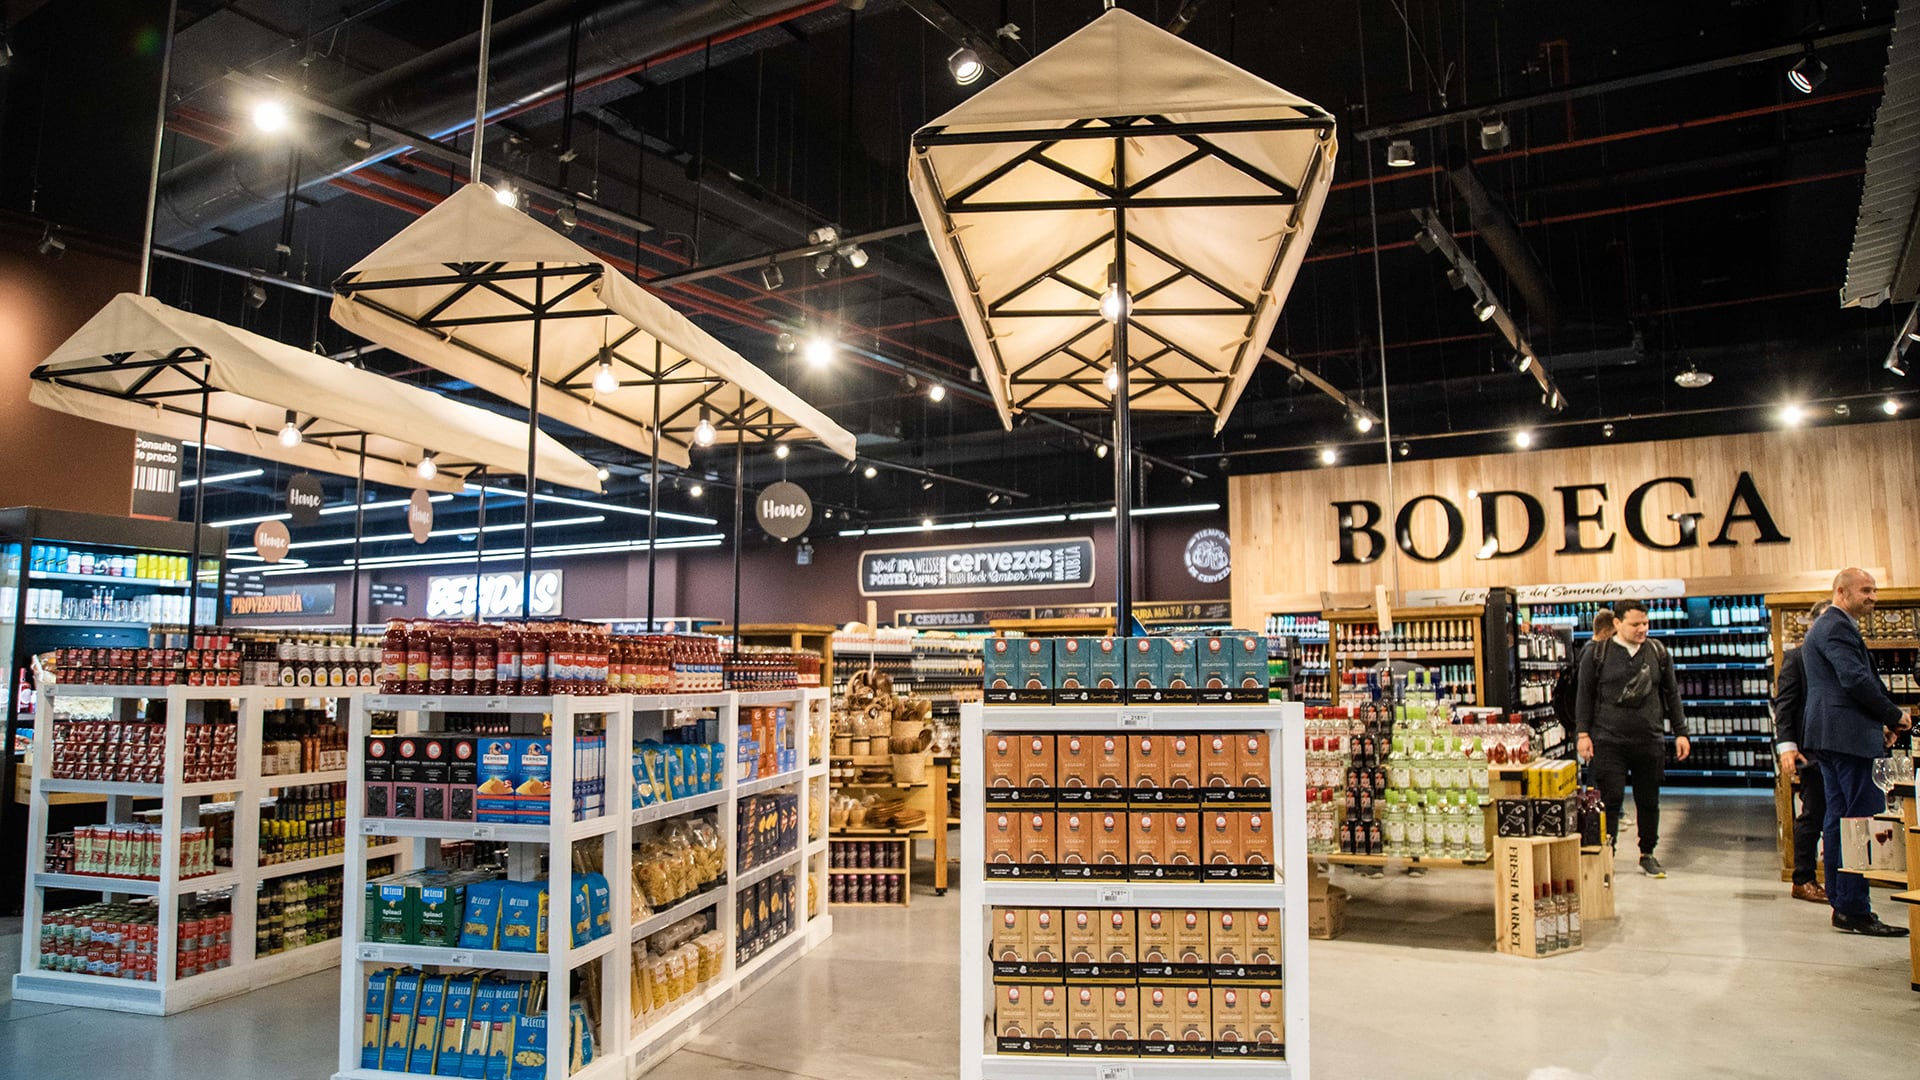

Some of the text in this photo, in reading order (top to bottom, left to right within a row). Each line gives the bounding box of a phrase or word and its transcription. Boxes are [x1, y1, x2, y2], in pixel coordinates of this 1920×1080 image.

[146, 452, 178, 463] precio
[290, 488, 321, 508] Home
[763, 500, 807, 519] Home
[1331, 470, 1791, 565] BODEGA
[259, 532, 287, 549] Home
[1194, 528, 1226, 542] TIEMPO
[896, 558, 915, 573] IPA
[947, 549, 1052, 573] cervezas
[1053, 548, 1065, 581] MALTA
[1065, 546, 1081, 580] RUBIA
[869, 572, 908, 587] PORTER
[1552, 583, 1624, 598] Sommelier
[915, 613, 975, 625] CERVEZAS
[1509, 846, 1521, 949] FRESH MARKET
